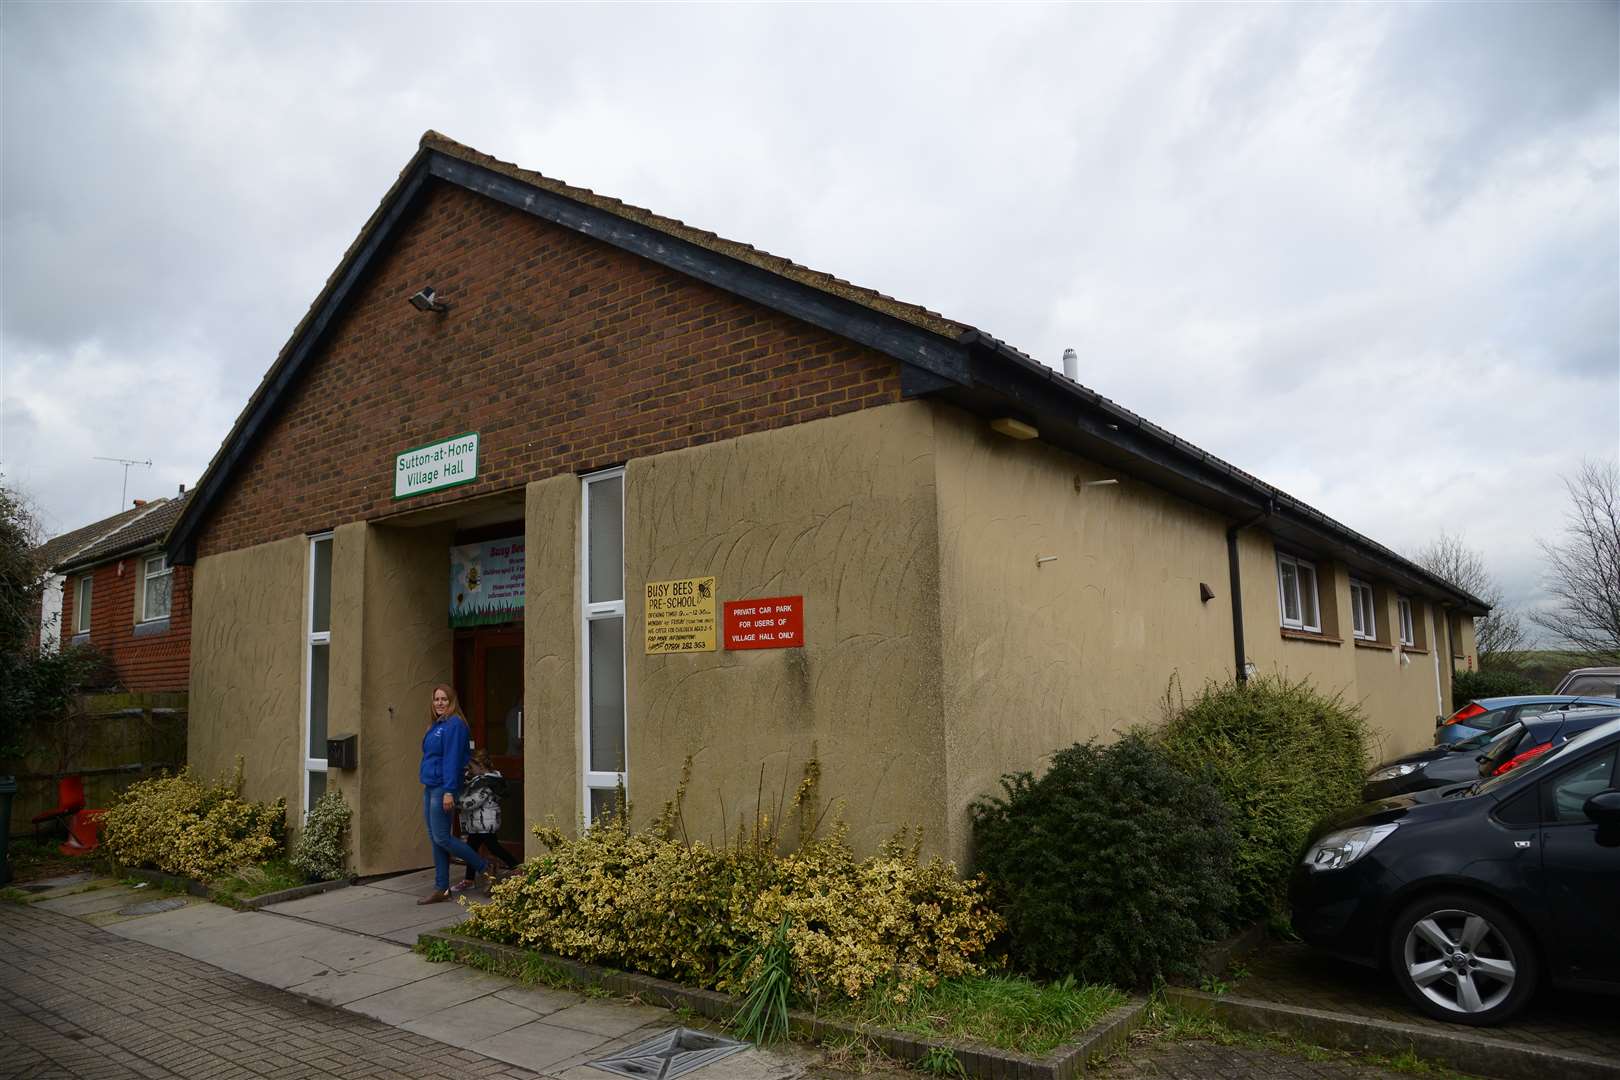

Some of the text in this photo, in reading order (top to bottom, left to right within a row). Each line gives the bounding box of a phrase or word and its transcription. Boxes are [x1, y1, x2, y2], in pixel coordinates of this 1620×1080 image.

[399, 441, 474, 471] Sutton-at-Hone
[407, 459, 464, 487] Village Hall
[647, 581, 693, 598] BUSY BEES
[649, 596, 697, 610] PRE-SCHOOL
[733, 605, 792, 616] PRIVATE CAR PARK
[754, 619, 774, 628] USERS
[778, 618, 787, 626] OF
[731, 631, 795, 642] VILLAGE HALL ONLY
